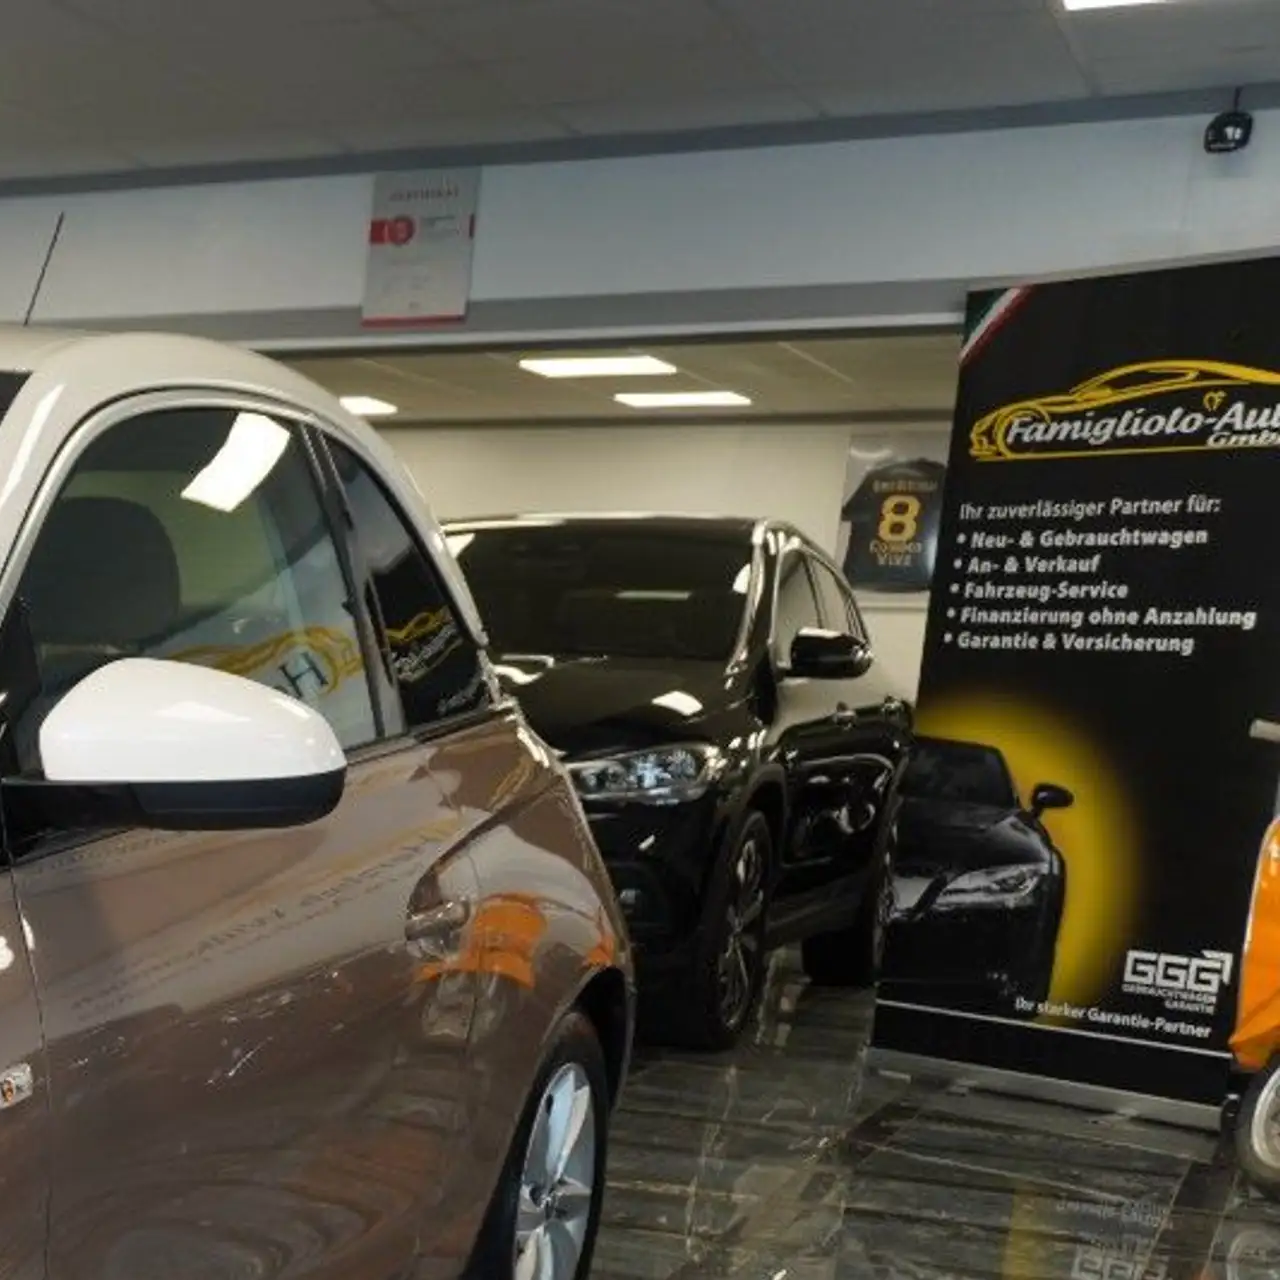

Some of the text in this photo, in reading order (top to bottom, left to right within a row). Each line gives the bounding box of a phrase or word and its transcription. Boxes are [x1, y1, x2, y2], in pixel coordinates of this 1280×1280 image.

[878, 495, 921, 542] 8
[960, 494, 1221, 522] Ihr zuverlässiger Partner für:
[970, 527, 1209, 549] Neu- & Gebrauchtwagen
[967, 553, 1102, 573] An- & Verkauf
[964, 580, 1129, 602] Fahrzeug-Service
[960, 606, 1258, 630] Finanzierung ohne Anzahlung
[957, 631, 1195, 656] Garantie & Versicherung
[1123, 950, 1228, 994] GGG
[1015, 996, 1212, 1039] Ihr starker Garantie-Partner
